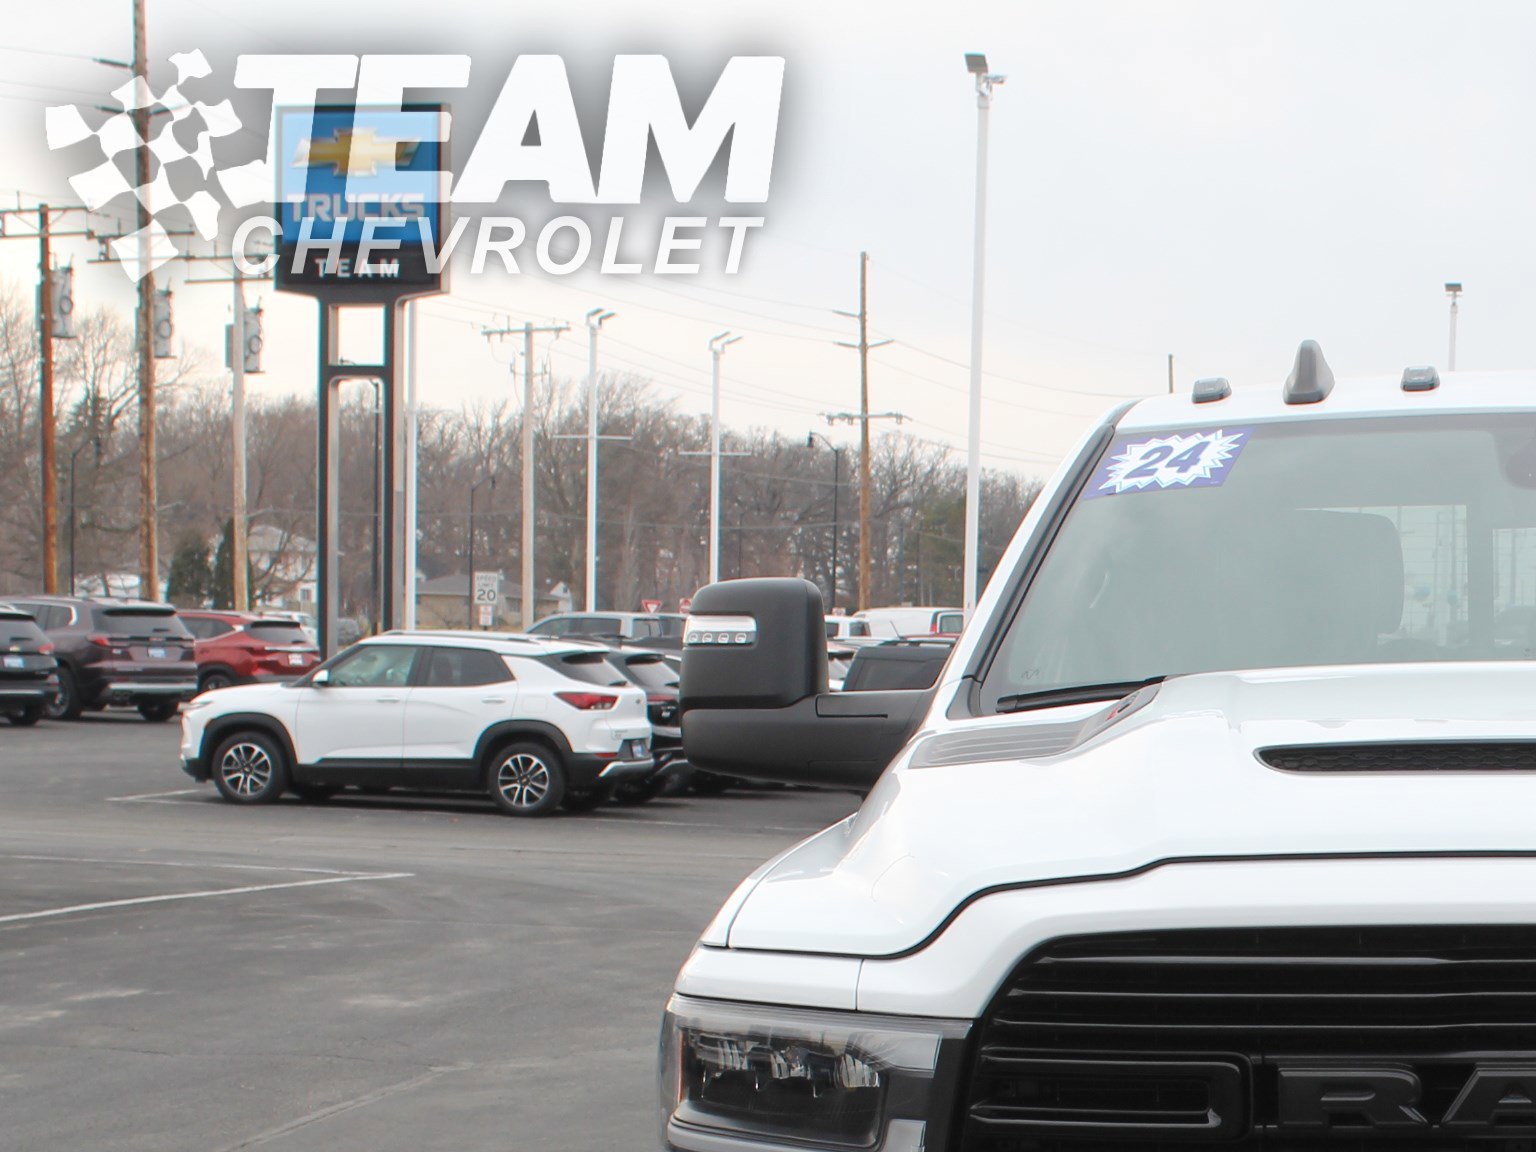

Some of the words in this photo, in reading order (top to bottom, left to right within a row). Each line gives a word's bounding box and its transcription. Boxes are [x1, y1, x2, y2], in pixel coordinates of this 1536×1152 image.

[286, 193, 425, 223] TRUCKS
[315, 257, 401, 279] TEAM
[1123, 441, 1211, 480] 24
[477, 589, 496, 601] 20
